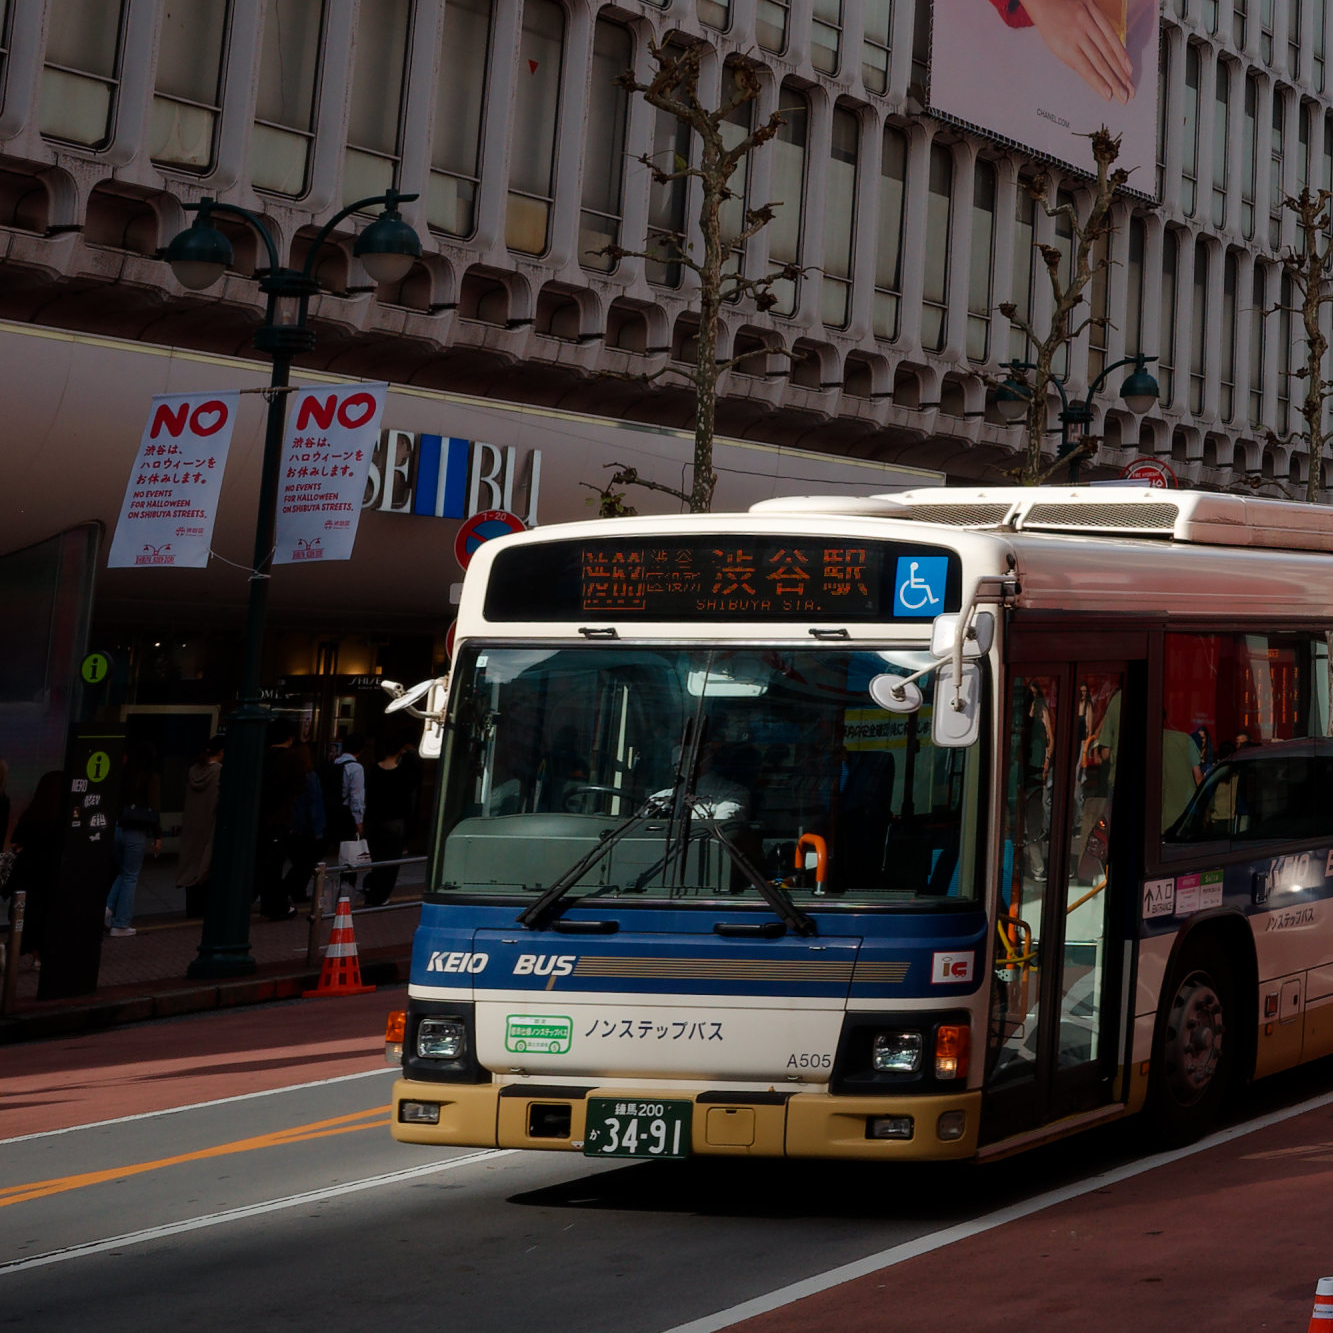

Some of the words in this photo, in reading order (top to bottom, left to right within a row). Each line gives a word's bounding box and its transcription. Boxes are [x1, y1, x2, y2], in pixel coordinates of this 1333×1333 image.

[296, 392, 377, 431] NO
[150, 400, 228, 439] NO
[291, 437, 331, 449] 渋谷は、
[143, 445, 183, 457] 渋谷は、
[289, 450, 364, 463] ハロウィーンを
[140, 457, 216, 470] ハロウィーンを
[286, 465, 354, 478] お休みします。
[136, 473, 207, 485] お休みします。
[284, 484, 295, 492] NO
[295, 482, 322, 491] EVENTS
[133, 491, 145, 499] NO
[145, 489, 172, 498] EVENTS
[283, 495, 296, 503] FOR
[297, 492, 339, 502] HALLOWEEN
[131, 501, 145, 509] FOR
[146, 499, 191, 508] HALLOWEEN
[282, 506, 293, 514] ON
[293, 504, 320, 513] SHIBUYA
[321, 502, 354, 512] STREETS.
[127, 511, 140, 519] ON
[140, 511, 171, 519] SHIBUYA
[173, 510, 208, 519] STREETS.
[483, 511, 507, 521] 7-20
[711, 548, 868, 597] 渋谷駅
[1154, 882, 1173, 900] 入口
[1265, 907, 1314, 932] ノンステップバス
[426, 951, 489, 974] KEIO
[512, 954, 577, 976] BUS
[585, 1019, 724, 1041] ノンステップバス
[787, 1052, 832, 1069] A505
[614, 1103, 664, 1117] 練馬200
[588, 1129, 601, 1141] か
[602, 1117, 682, 1155] 34-91
